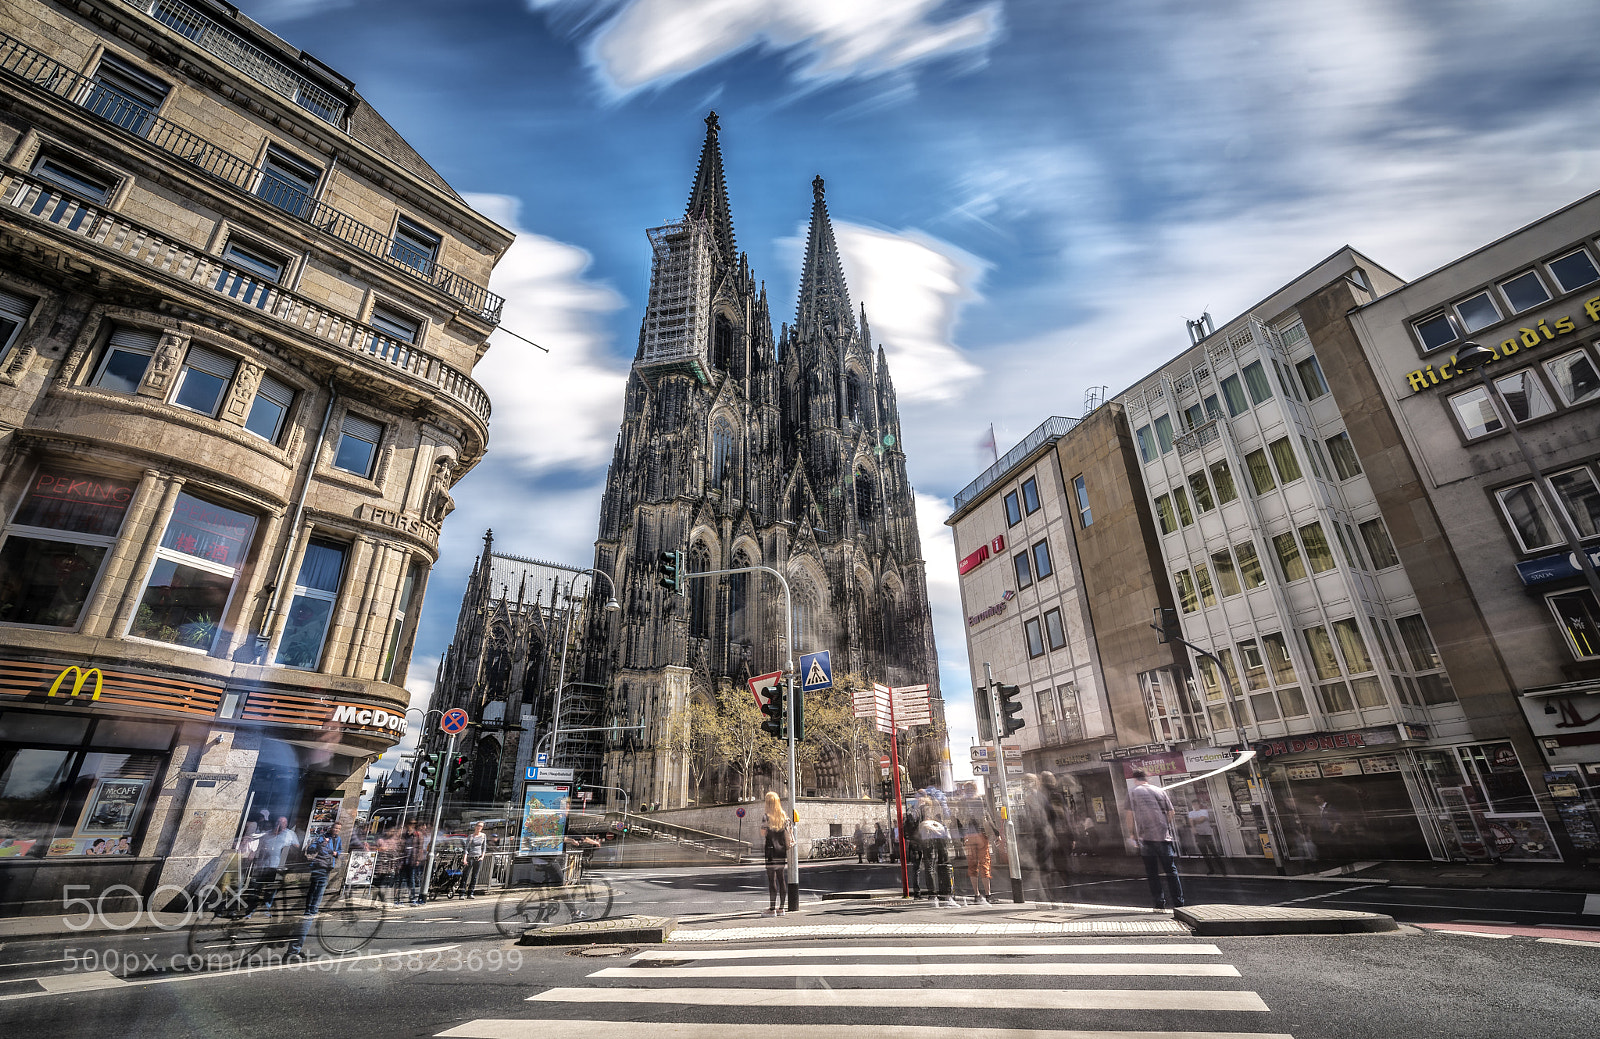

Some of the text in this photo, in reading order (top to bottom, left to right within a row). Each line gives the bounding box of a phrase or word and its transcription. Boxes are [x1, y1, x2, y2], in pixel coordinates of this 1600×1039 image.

[36, 475, 132, 502] PEKING
[175, 501, 249, 537] PEKING
[967, 601, 1007, 627] Eurowings
[1142, 759, 1165, 767] frozen
